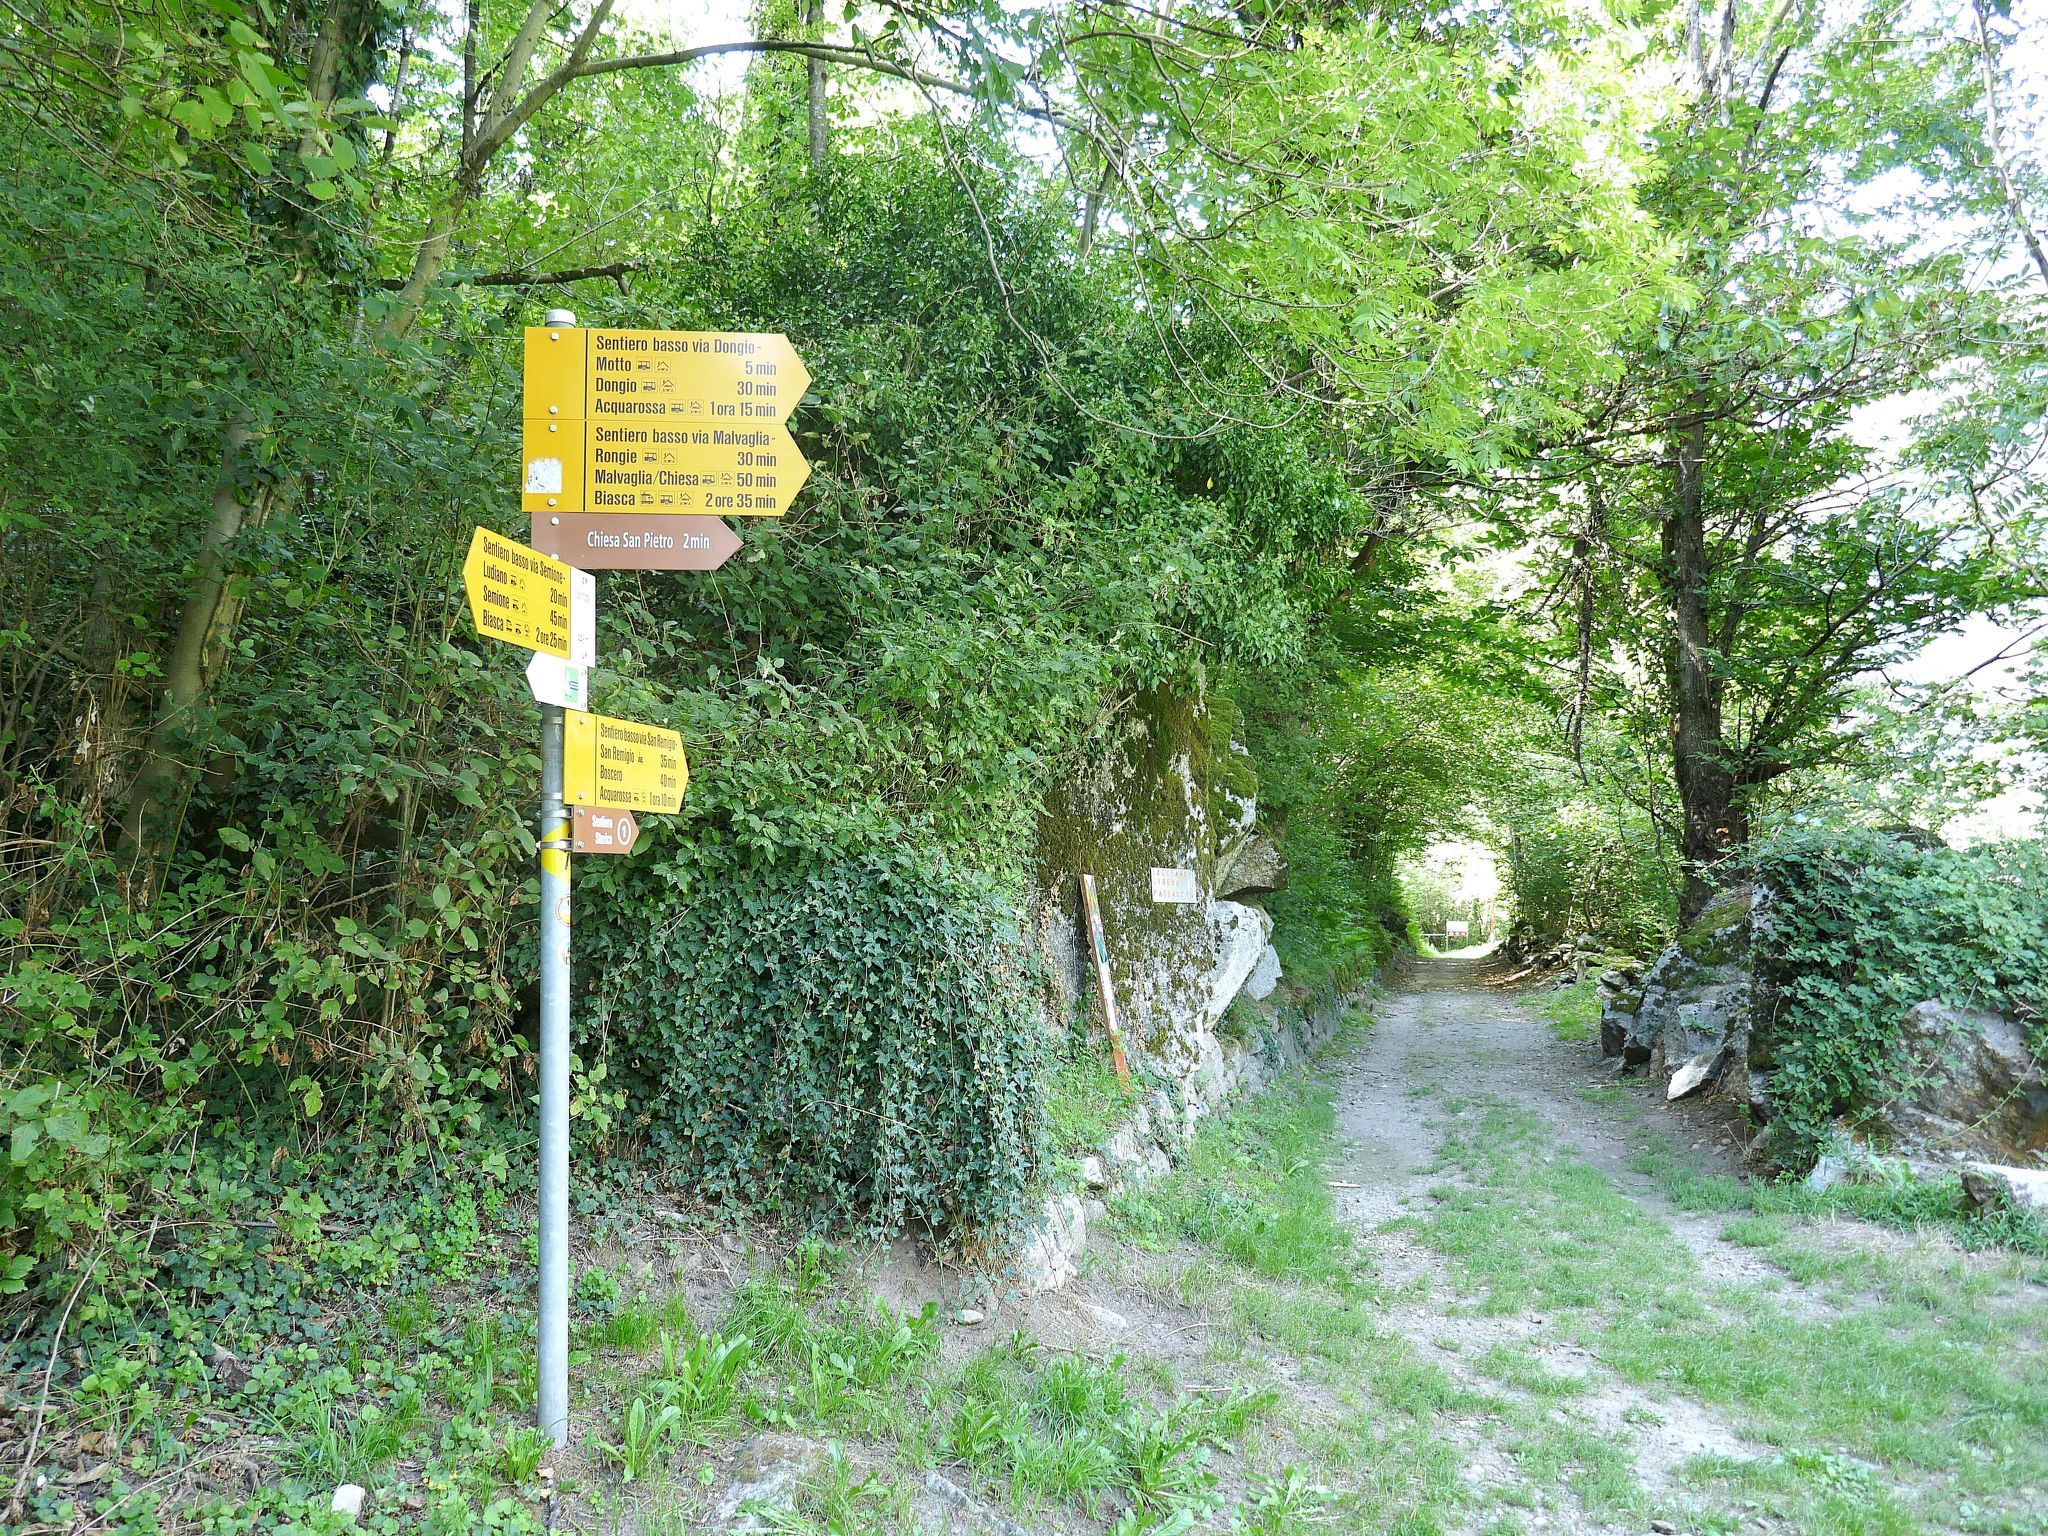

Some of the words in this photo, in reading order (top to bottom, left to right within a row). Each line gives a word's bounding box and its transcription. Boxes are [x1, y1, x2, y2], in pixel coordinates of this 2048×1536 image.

[597, 336, 647, 351] Sentiero
[653, 337, 688, 352] basso
[692, 339, 709, 352] via
[596, 357, 631, 372] Motto
[746, 362, 753, 374] 5
[756, 362, 776, 375] min
[596, 378, 636, 395] Dongio
[737, 381, 752, 395] 30
[756, 383, 776, 396] min
[595, 399, 665, 416] Acquarossa
[740, 403, 752, 416] 15
[756, 403, 776, 417] min
[596, 427, 647, 442] Sentiero
[653, 429, 687, 443] basso
[692, 430, 709, 444] via
[596, 449, 636, 465] Rongie
[738, 452, 752, 466] 30
[756, 453, 776, 466] min
[595, 469, 698, 486] Malvaglia/Chiesa
[737, 473, 752, 487] 50
[756, 474, 776, 487] min
[595, 491, 635, 506] Biasca
[706, 493, 712, 506] 2
[716, 497, 733, 507] ore
[737, 494, 752, 508] 35
[756, 495, 776, 508] min
[588, 531, 619, 547] Chiesa
[623, 532, 640, 548] San
[644, 532, 673, 548] Pietro
[484, 537, 509, 562] Sentiero
[512, 548, 528, 570] basso
[530, 558, 538, 573] via
[484, 561, 507, 584] Ludiano
[551, 588, 557, 603] 20
[558, 592, 567, 608] min
[483, 585, 509, 609] Semione
[550, 610, 557, 626] 45
[558, 614, 567, 629] min
[483, 610, 503, 631] Biasca
[536, 627, 539, 642] 2
[540, 632, 549, 645] ore
[550, 632, 557, 648] 25
[558, 636, 567, 651] min
[601, 723, 623, 740] Sentiero
[624, 728, 639, 743] basso
[647, 732, 656, 747] San
[601, 744, 611, 758] San
[613, 746, 634, 764] Remigio
[661, 755, 667, 768] 35
[668, 756, 676, 769] min
[600, 765, 622, 781] Boscero
[660, 774, 667, 787] 40
[668, 776, 676, 788] min
[600, 786, 631, 803] Acquarossa
